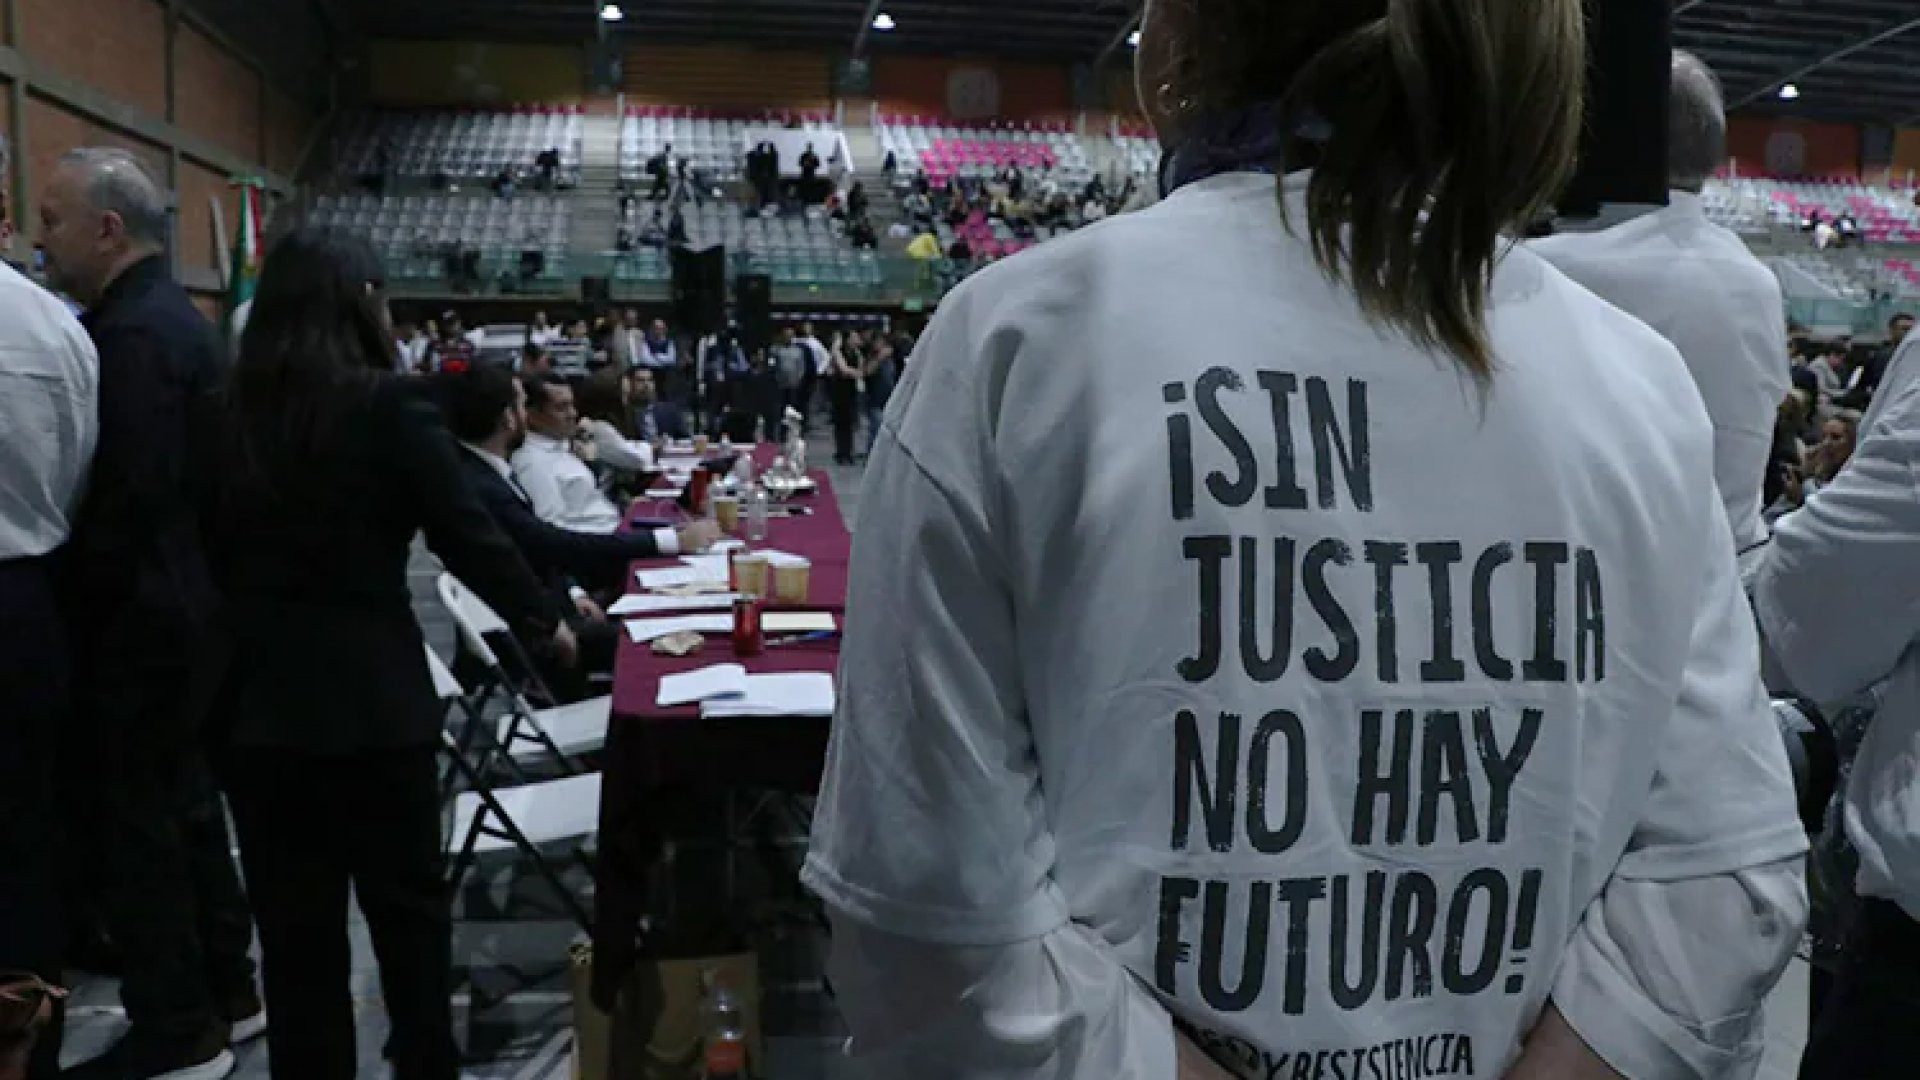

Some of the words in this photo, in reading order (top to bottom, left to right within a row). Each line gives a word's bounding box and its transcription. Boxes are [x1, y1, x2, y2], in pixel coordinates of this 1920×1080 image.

[1162, 366, 1373, 520] ¡SIN
[1175, 534, 1606, 684] JUSTICIA
[1170, 708, 1307, 854] NO
[1351, 706, 1544, 846] HAY
[1154, 867, 1544, 1015] FUTURO!
